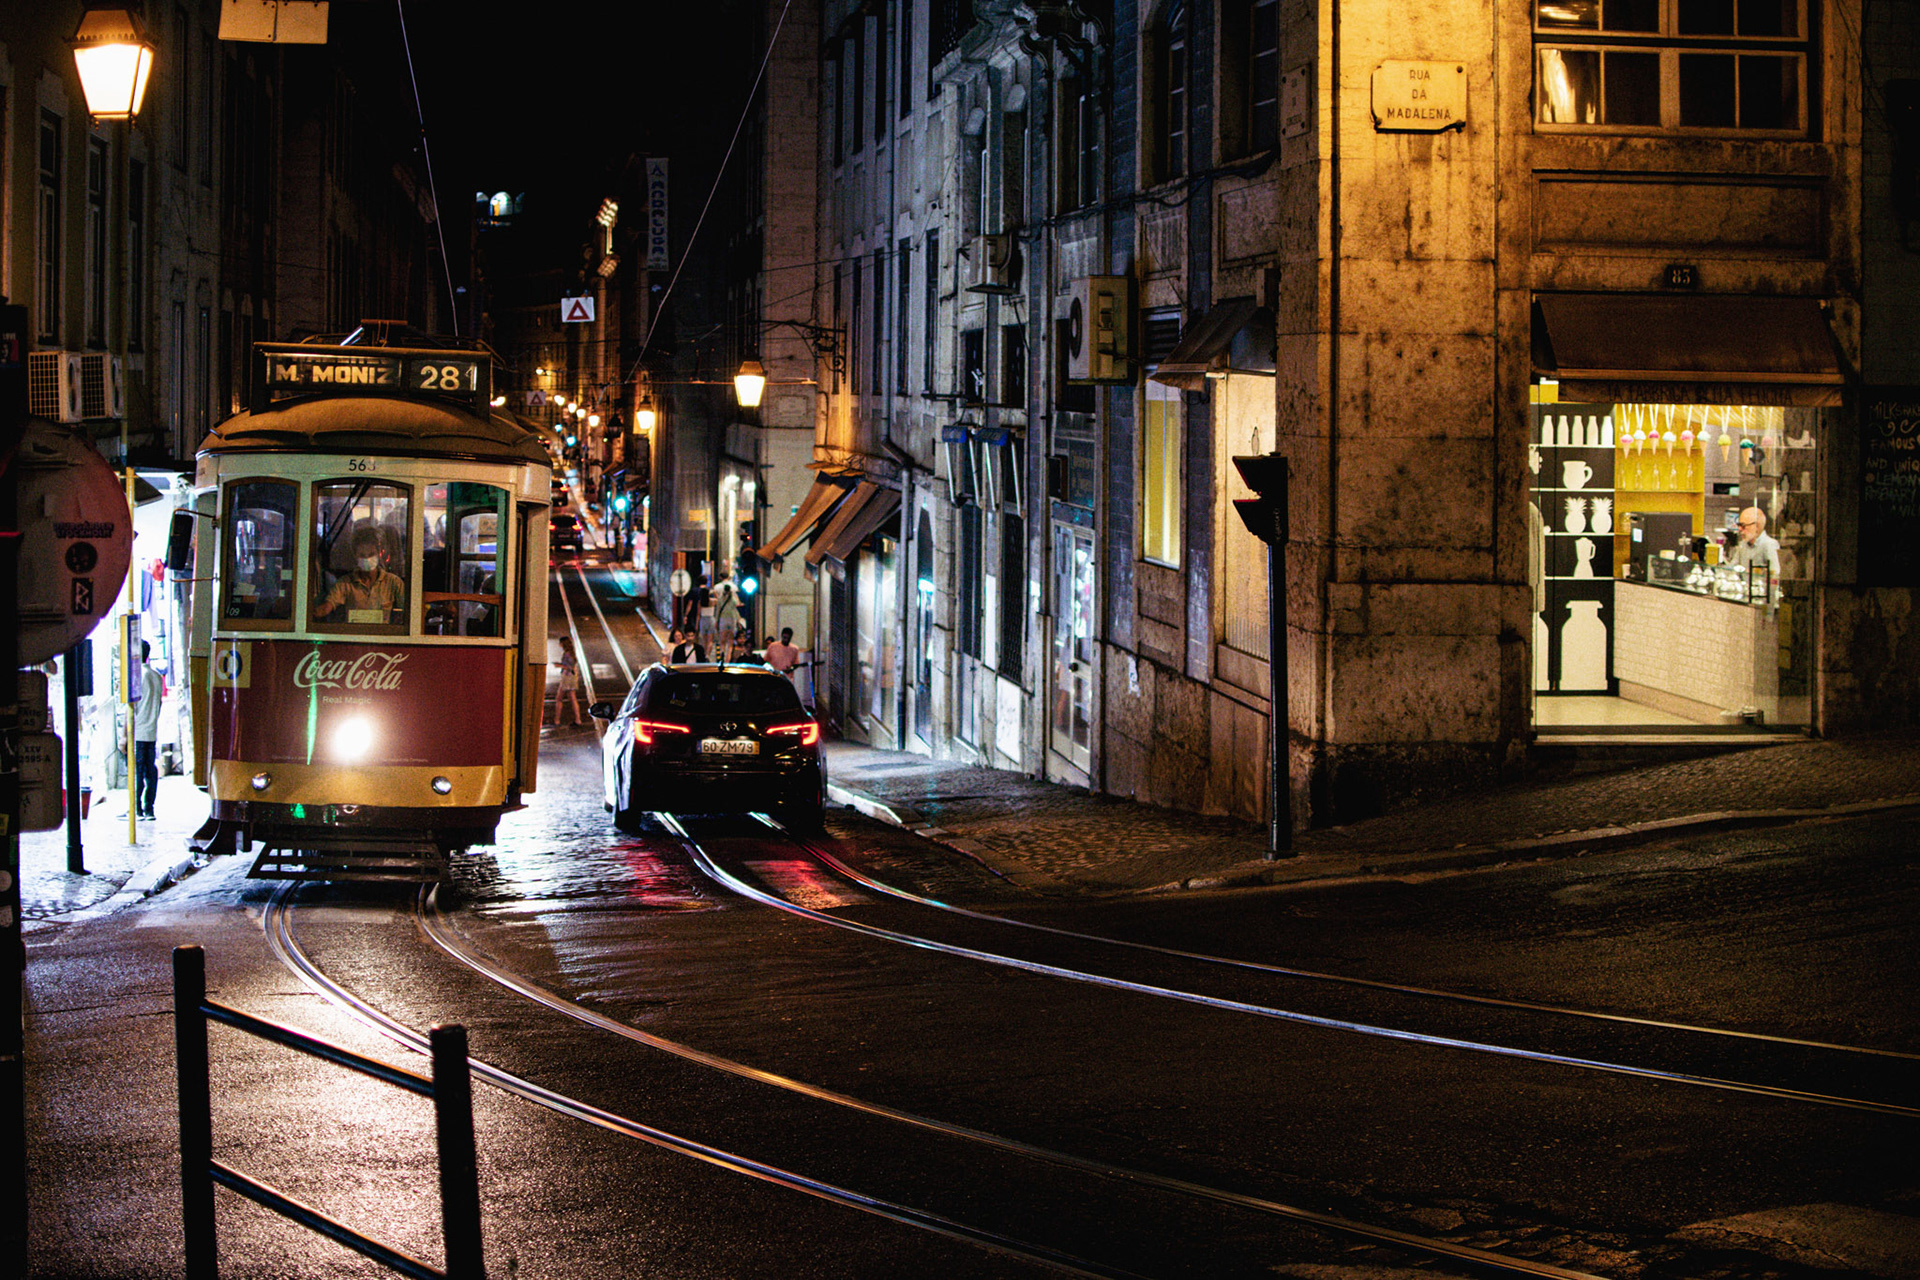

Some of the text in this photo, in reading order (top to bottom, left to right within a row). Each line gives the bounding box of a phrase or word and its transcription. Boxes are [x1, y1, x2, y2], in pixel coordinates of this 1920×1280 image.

[1409, 70, 1430, 80] RUA
[1411, 89, 1427, 99] DA
[1386, 108, 1451, 120] MADALENA
[312, 364, 395, 385] MONIZ
[293, 650, 409, 690] Coca-Cola
[322, 695, 372, 705] Real Magic
